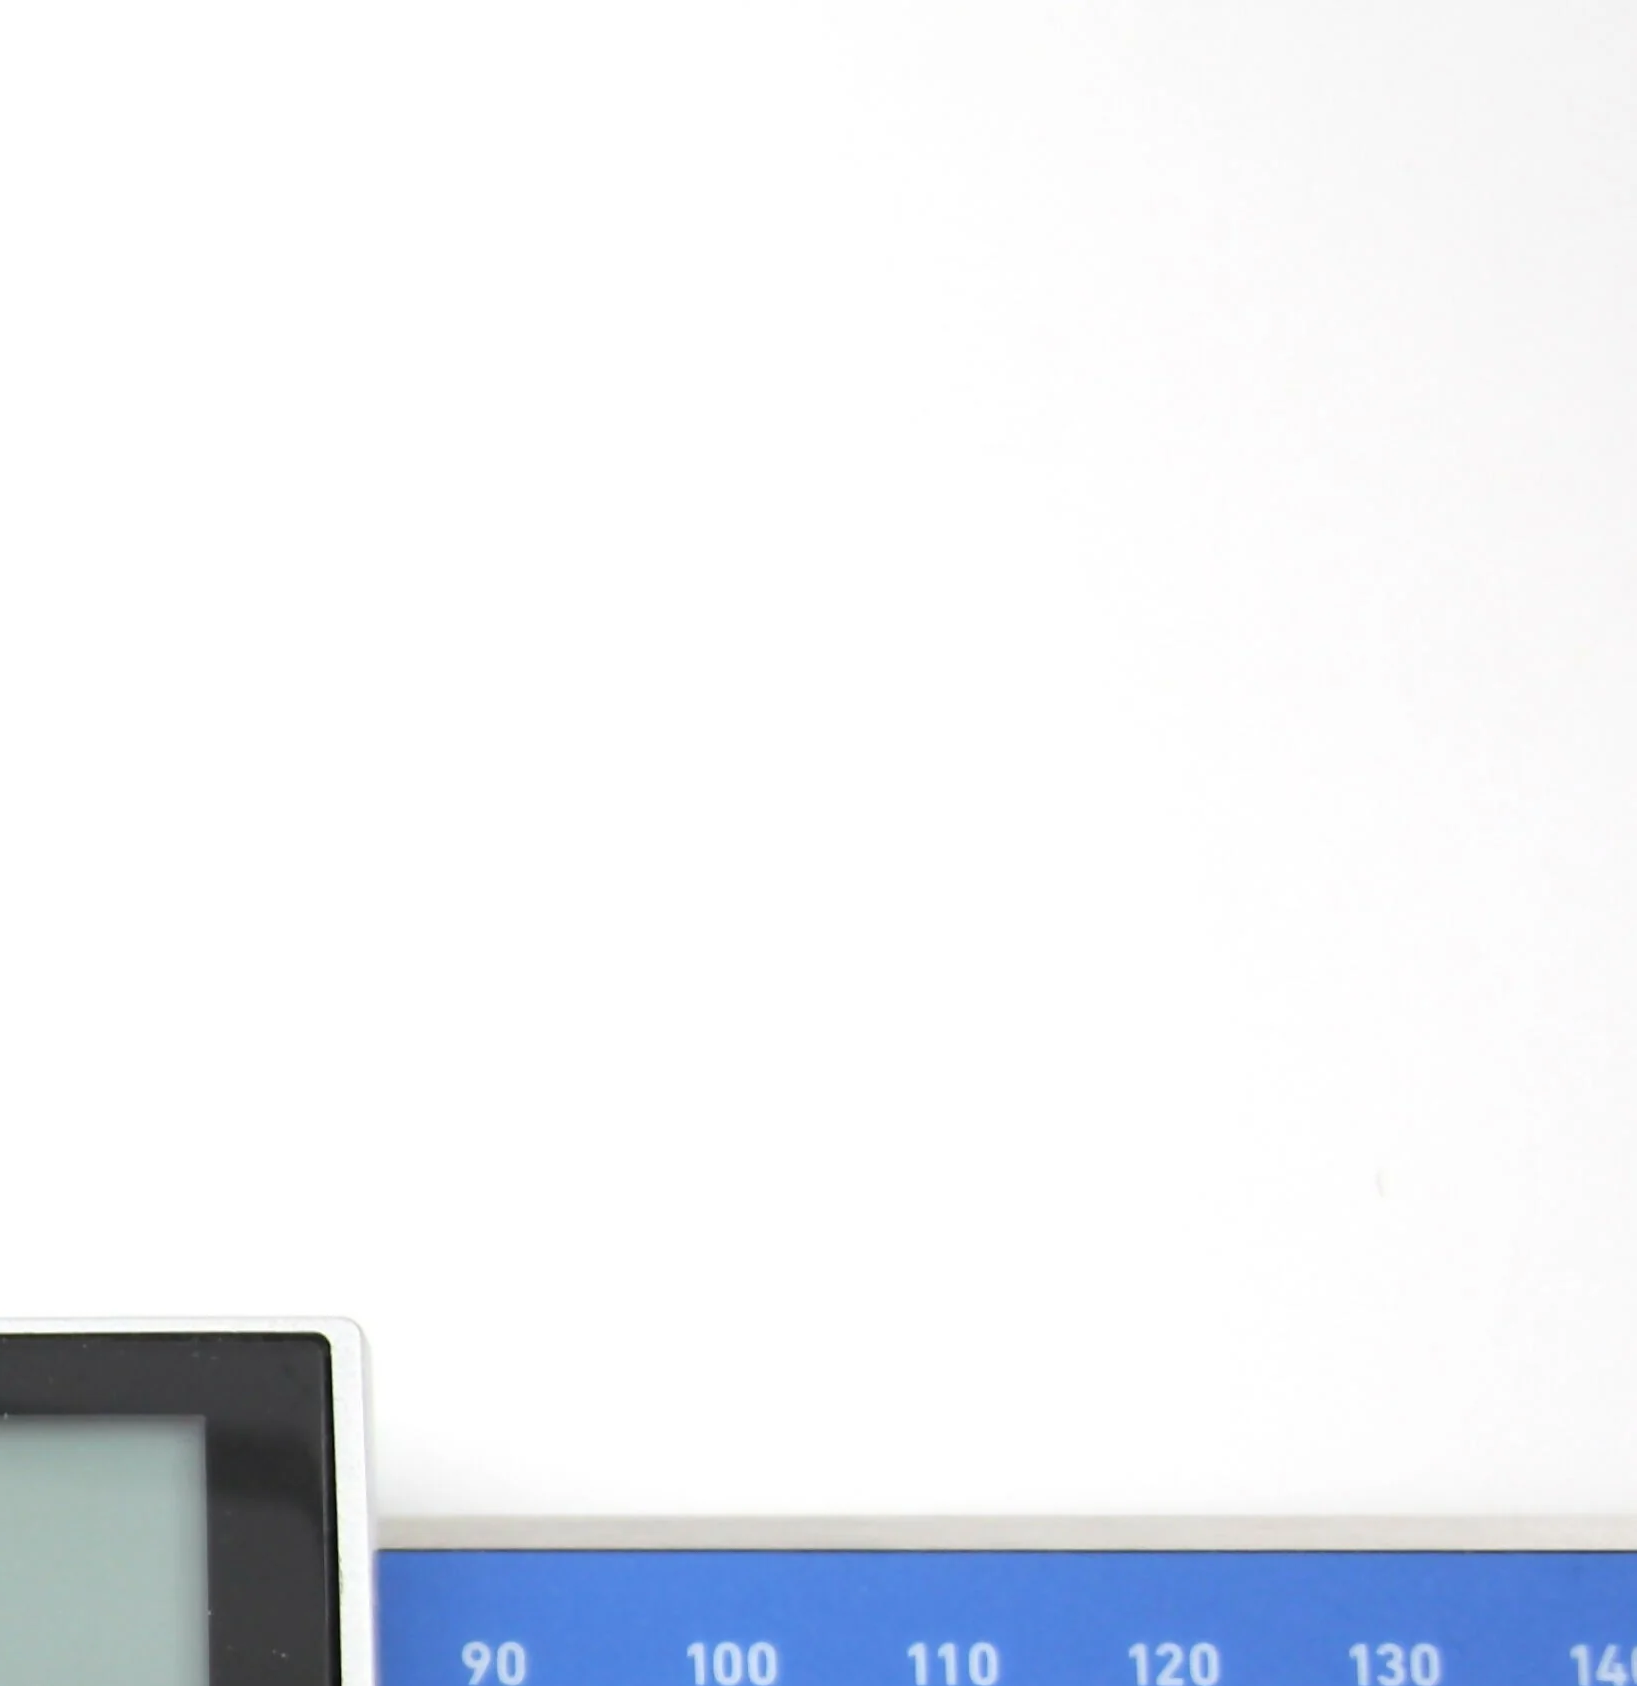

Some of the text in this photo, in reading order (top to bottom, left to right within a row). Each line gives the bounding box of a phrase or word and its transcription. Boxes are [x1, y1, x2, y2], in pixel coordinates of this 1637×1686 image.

[460, 1640, 527, 1686] 90
[685, 1640, 779, 1686] 100
[906, 1641, 1000, 1686] 110
